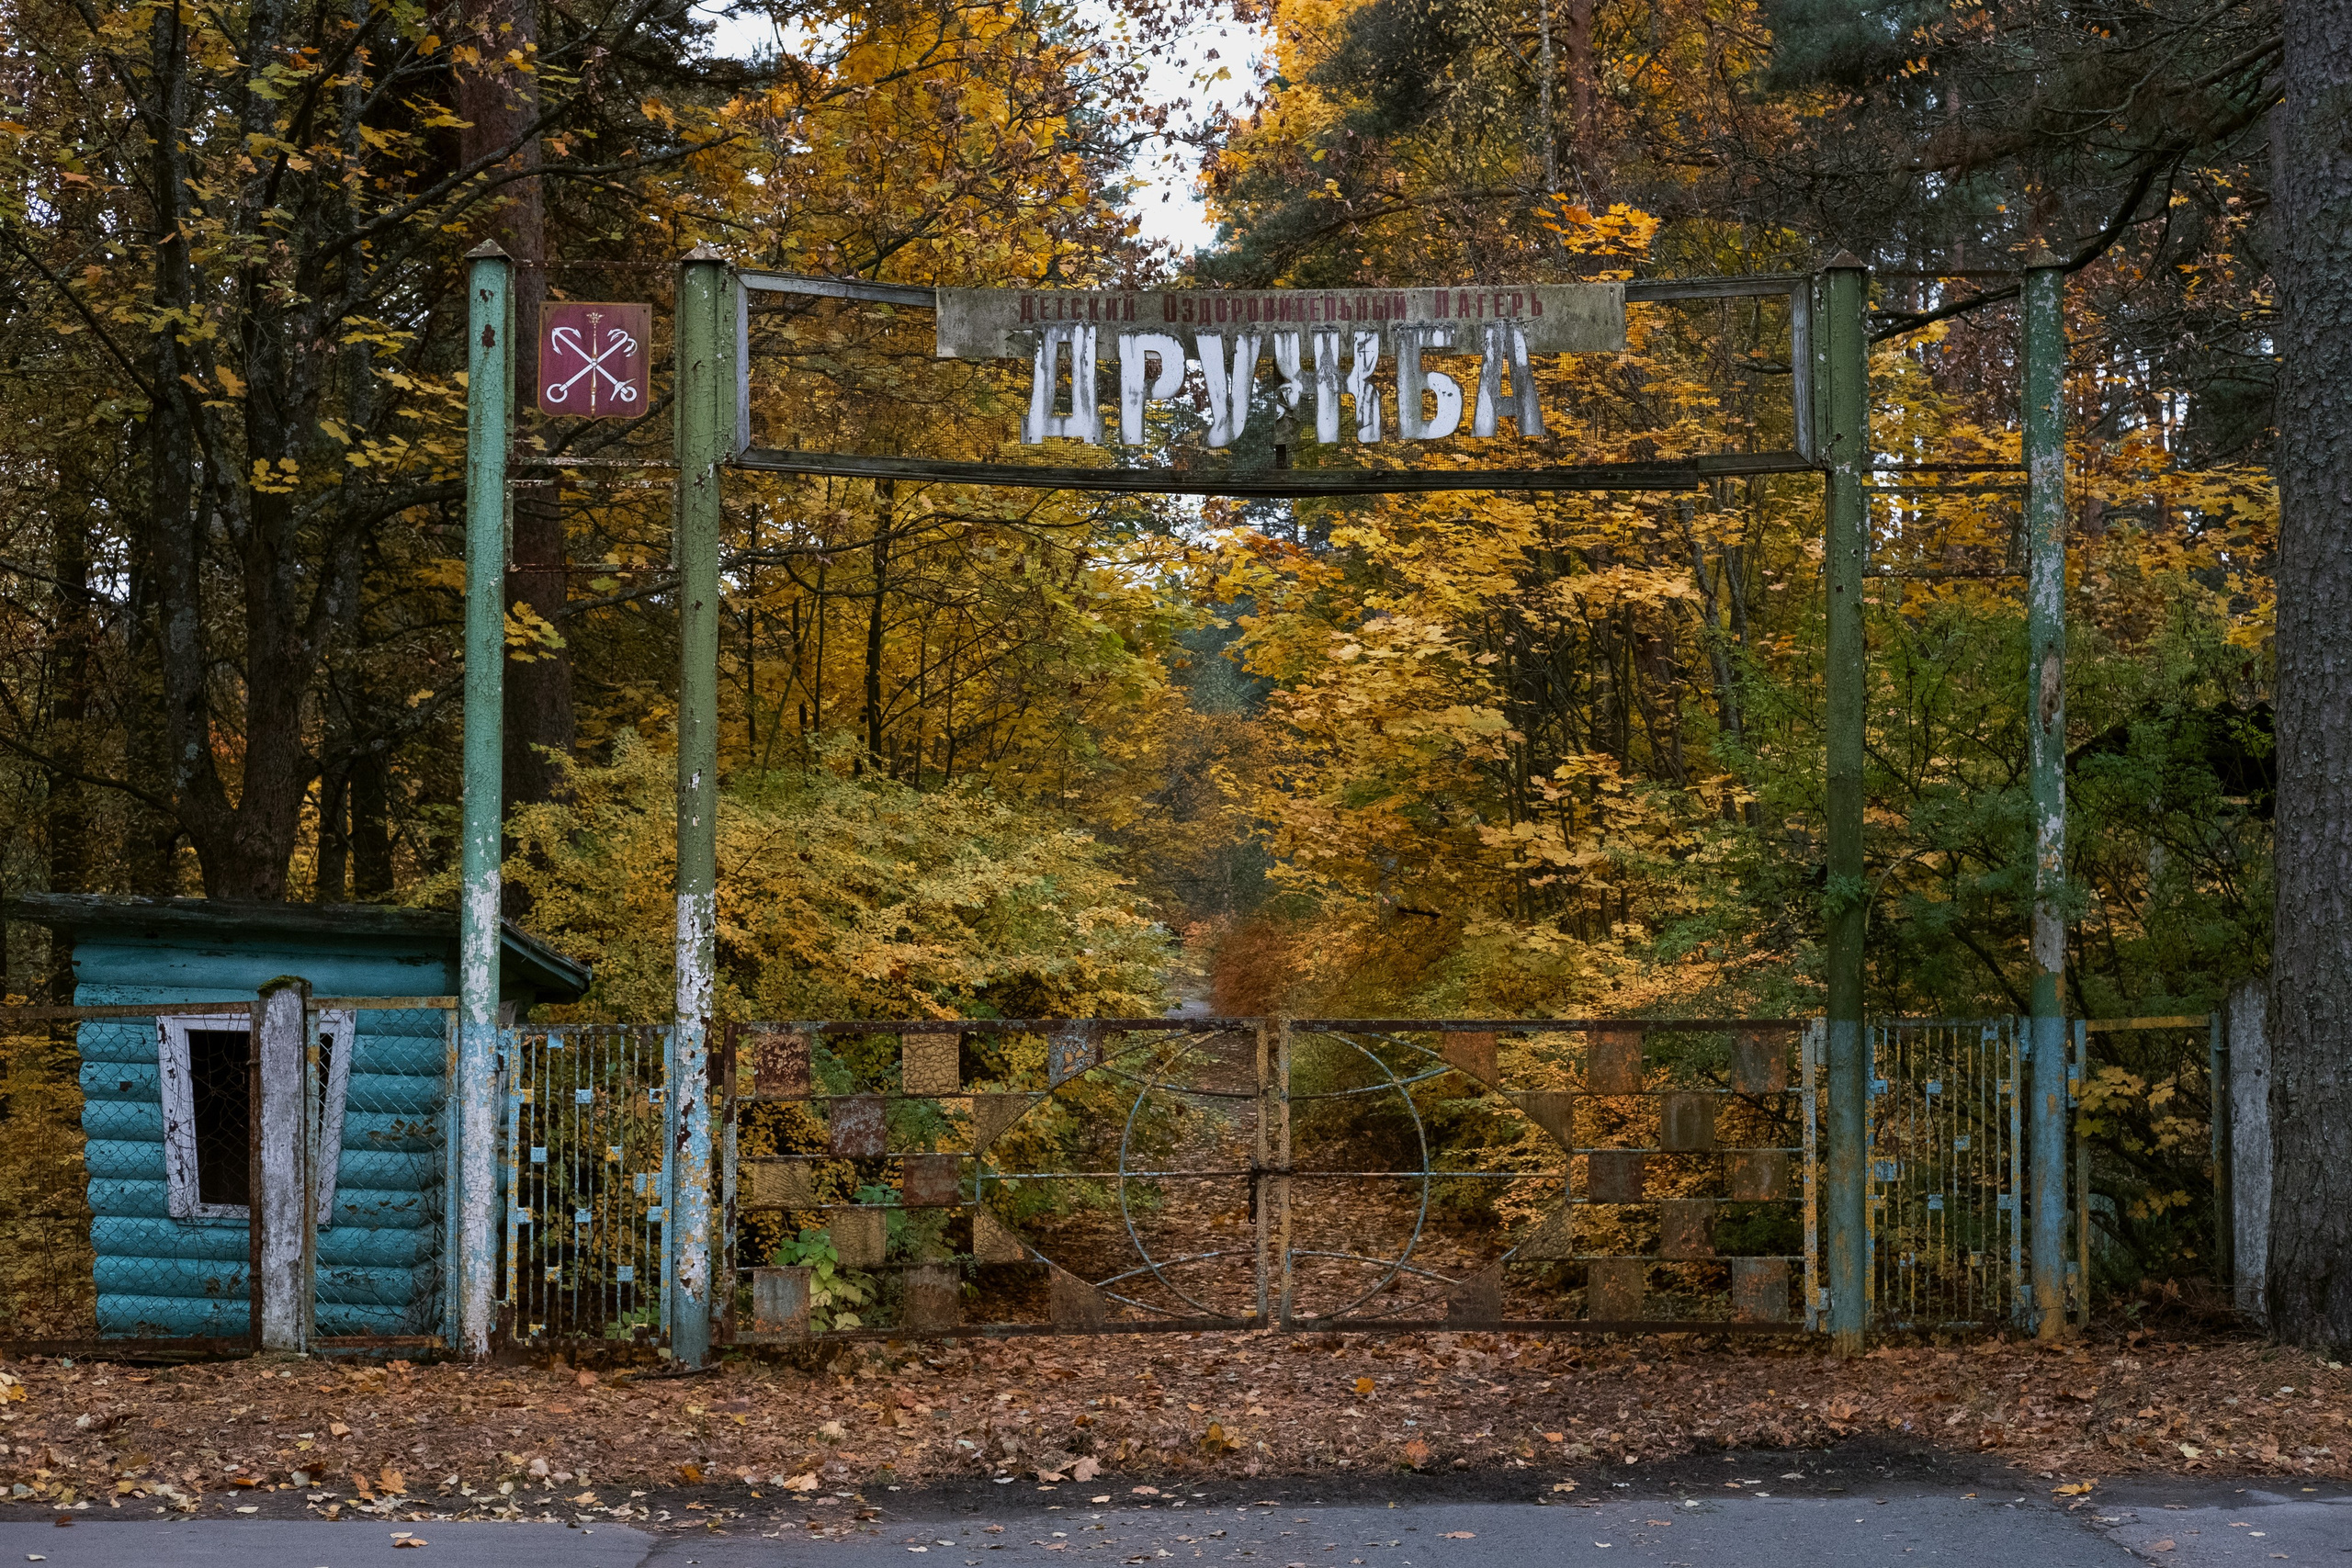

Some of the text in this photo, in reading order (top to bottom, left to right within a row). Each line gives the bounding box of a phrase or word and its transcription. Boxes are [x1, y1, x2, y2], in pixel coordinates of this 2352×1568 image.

[1019, 289, 1544, 326] ДЕТСКИЙ ОЗДОРОВИТЕЛЬНЫЙ ЛАГЕРЬ
[1020, 322, 1547, 447] ДРУЖБА
